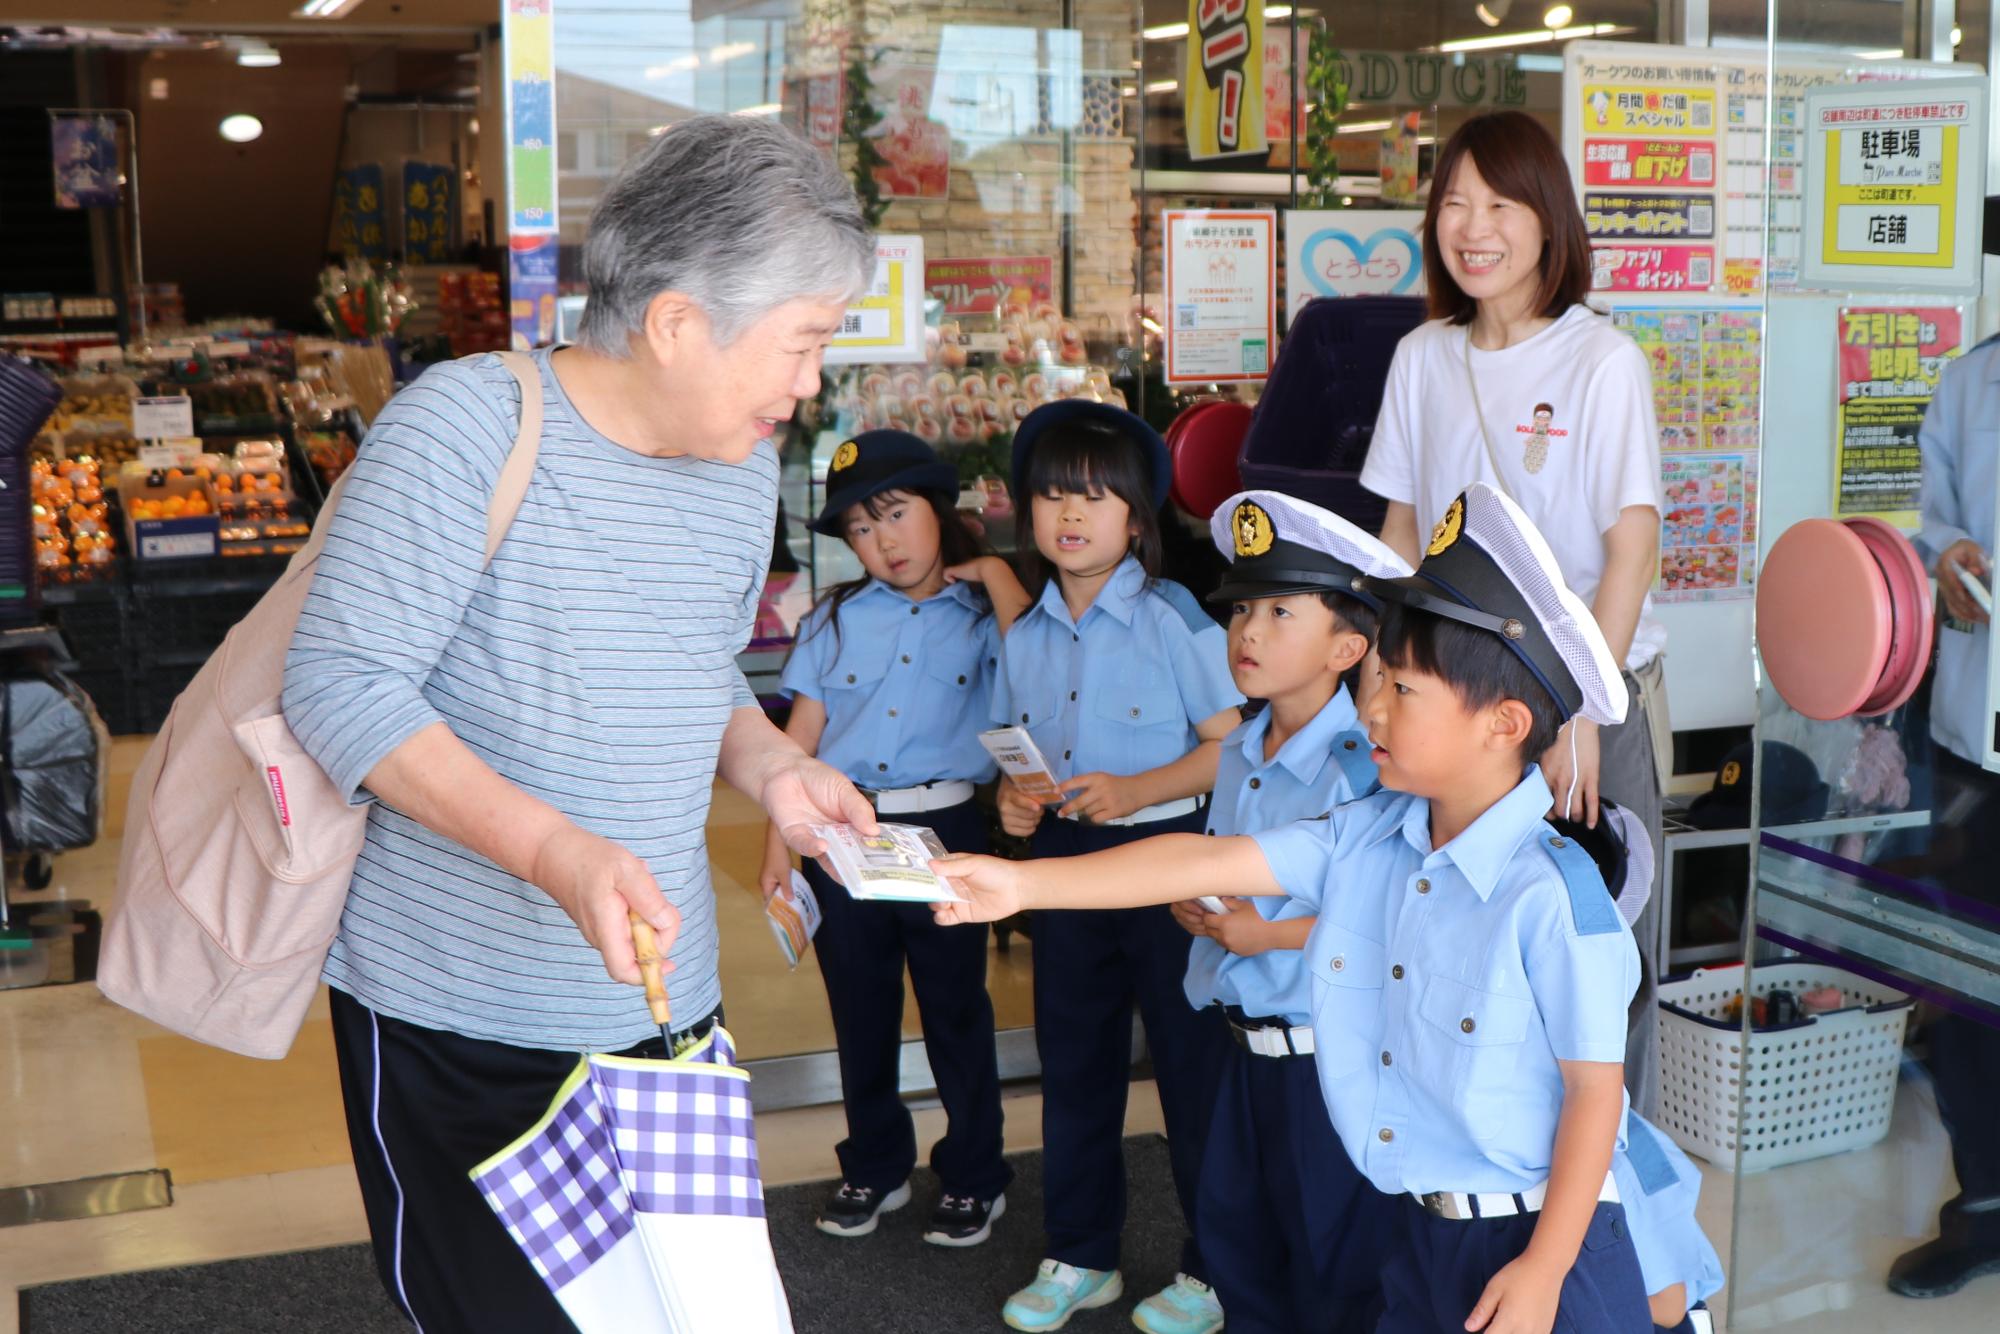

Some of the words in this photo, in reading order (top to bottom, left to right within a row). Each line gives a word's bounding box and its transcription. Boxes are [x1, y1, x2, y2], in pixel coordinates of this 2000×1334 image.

[1625, 112, 1685, 127] スペシャル
[1860, 129, 1921, 160] 駐車場
[1636, 155, 1688, 182] 値下げ
[524, 207, 544, 219] 150
[1586, 211, 1688, 235] ラッキーポイント
[1868, 214, 1908, 244] 店舗
[1626, 249, 1662, 267] アプリ
[1638, 271, 1684, 289] ポイント
[930, 281, 1012, 307] フルーツ
[1845, 313, 1938, 345] 万引きは
